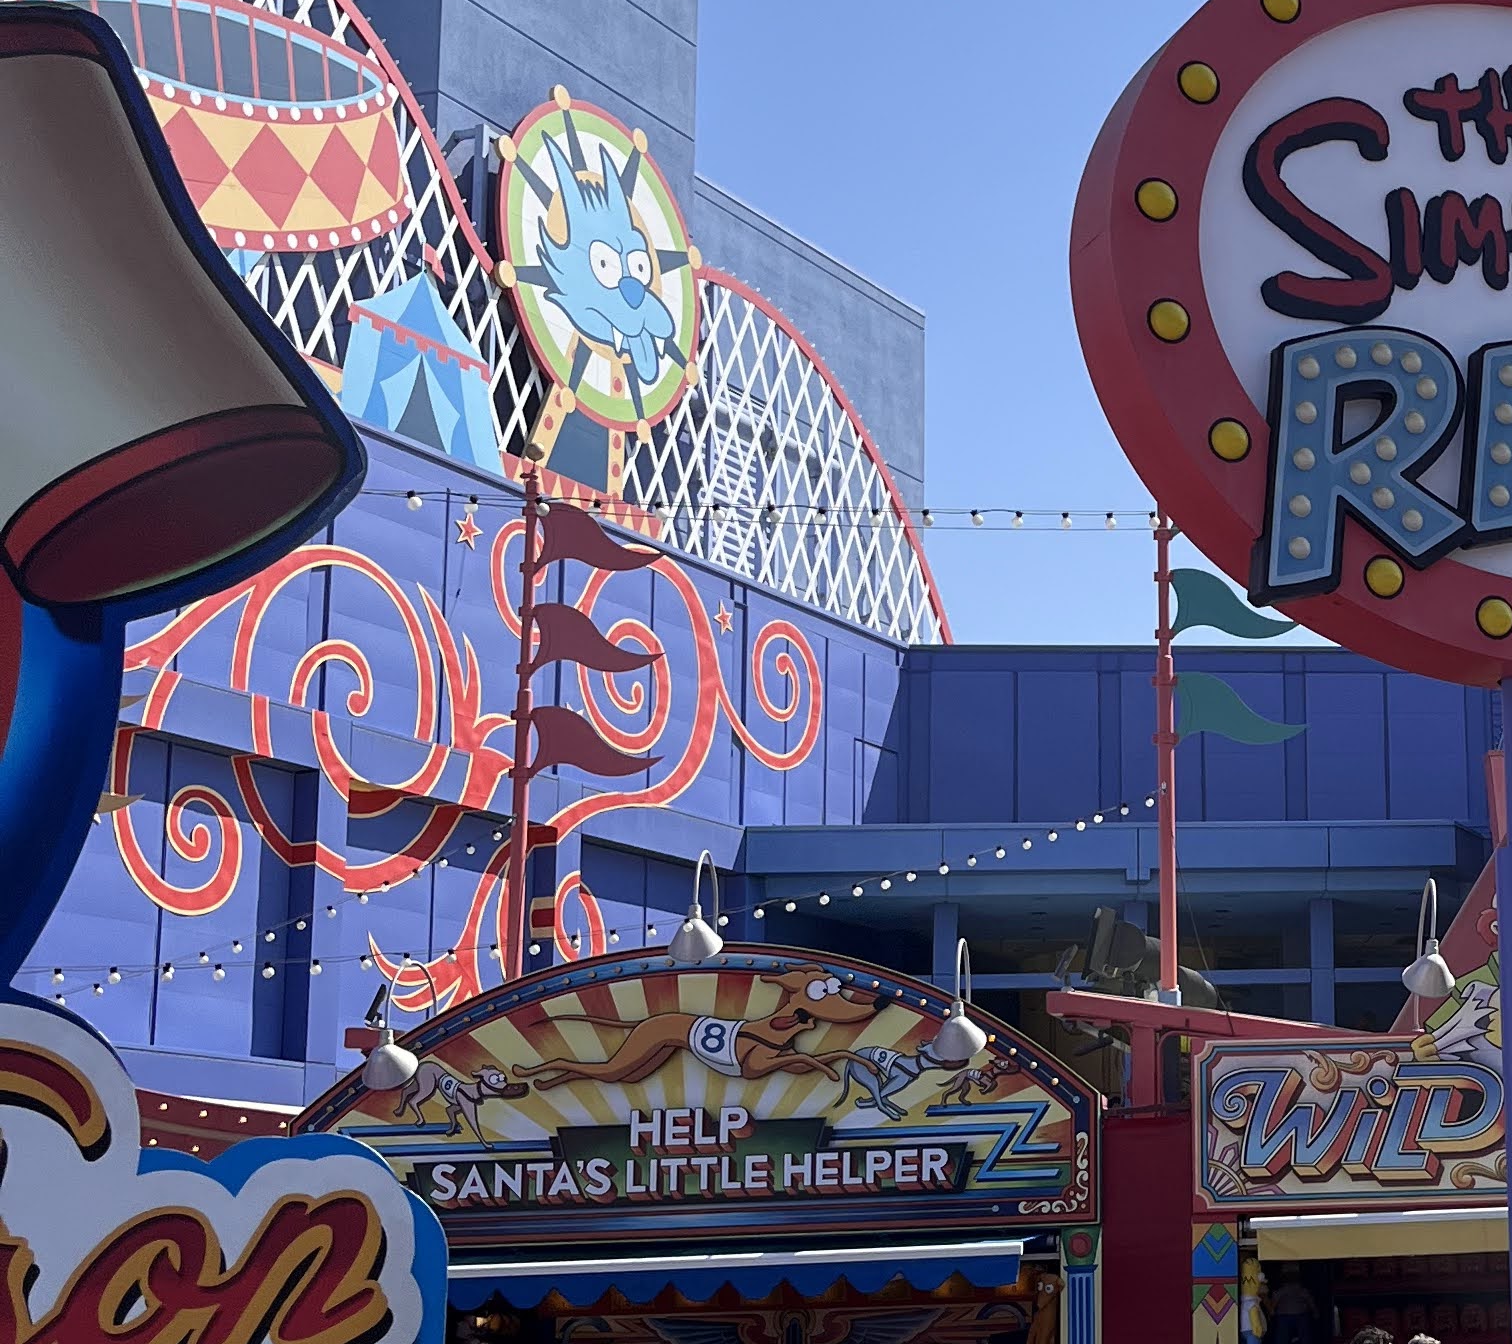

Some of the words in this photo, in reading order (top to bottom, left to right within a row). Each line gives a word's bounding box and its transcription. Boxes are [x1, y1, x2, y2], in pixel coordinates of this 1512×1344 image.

[701, 1022, 727, 1053] 8
[629, 1106, 750, 1151] HELP
[430, 1157, 614, 1202] SANTA'S
[625, 1154, 770, 1195] LITTLE
[784, 1147, 951, 1191] HELPER
